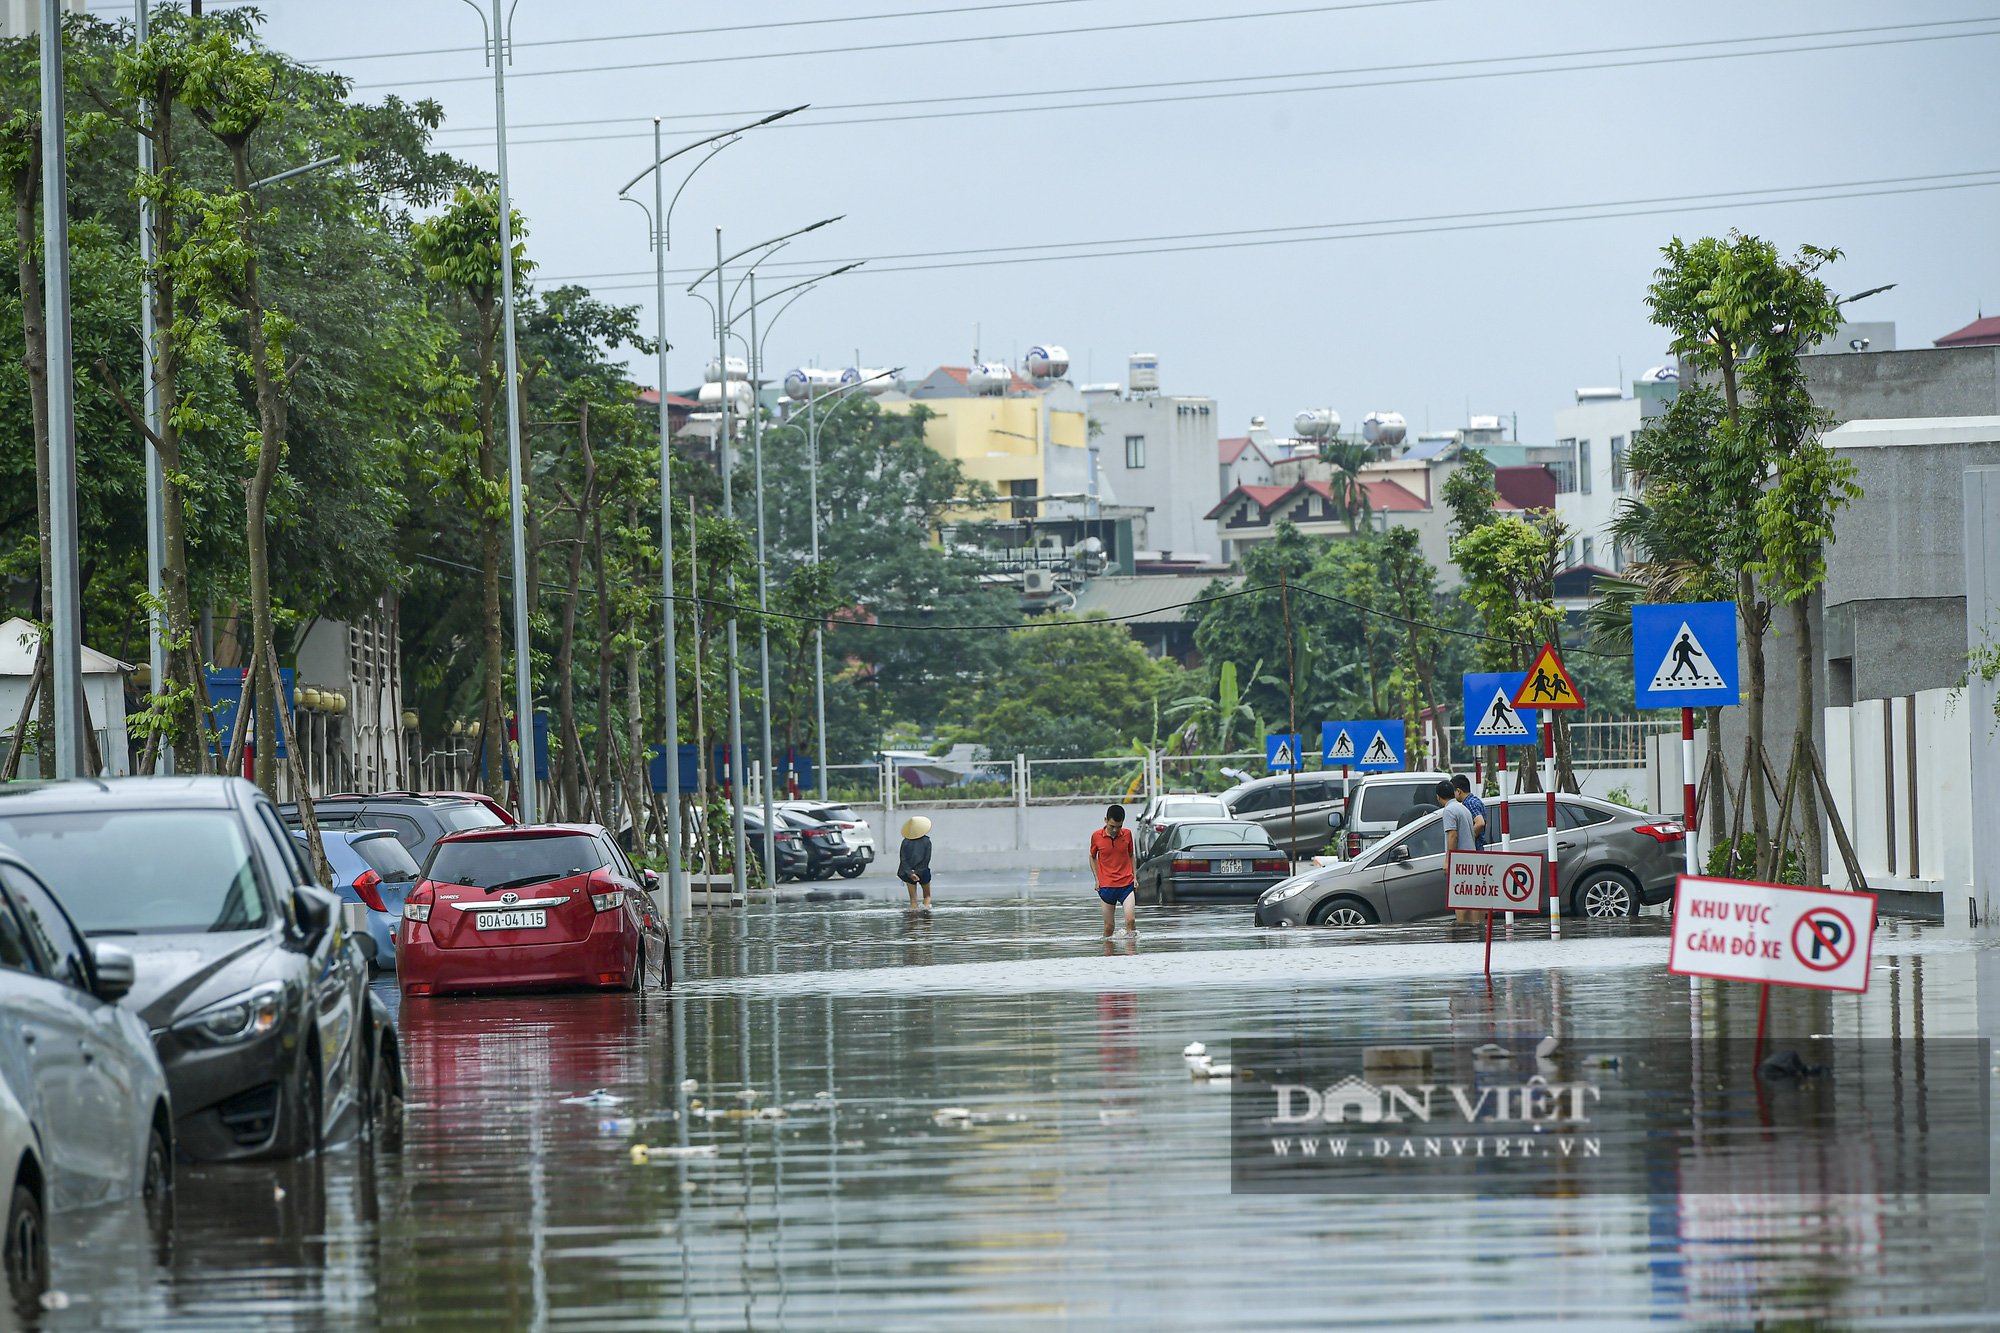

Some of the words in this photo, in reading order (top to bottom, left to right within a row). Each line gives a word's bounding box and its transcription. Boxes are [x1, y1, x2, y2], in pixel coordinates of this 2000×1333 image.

[1455, 863, 1474, 876] KHU
[1475, 863, 1493, 879] VỰC
[1454, 880, 1473, 896] CẤM
[1474, 880, 1487, 896] ĐỖ
[1488, 885, 1499, 897] XE
[479, 912, 544, 928] 90A-041.15
[1690, 899, 1729, 920] KHU
[1734, 903, 1772, 929] VỰC
[1687, 928, 1726, 954] CẤM
[1731, 931, 1756, 957] ĐỖ
[1760, 940, 1783, 960] XE
